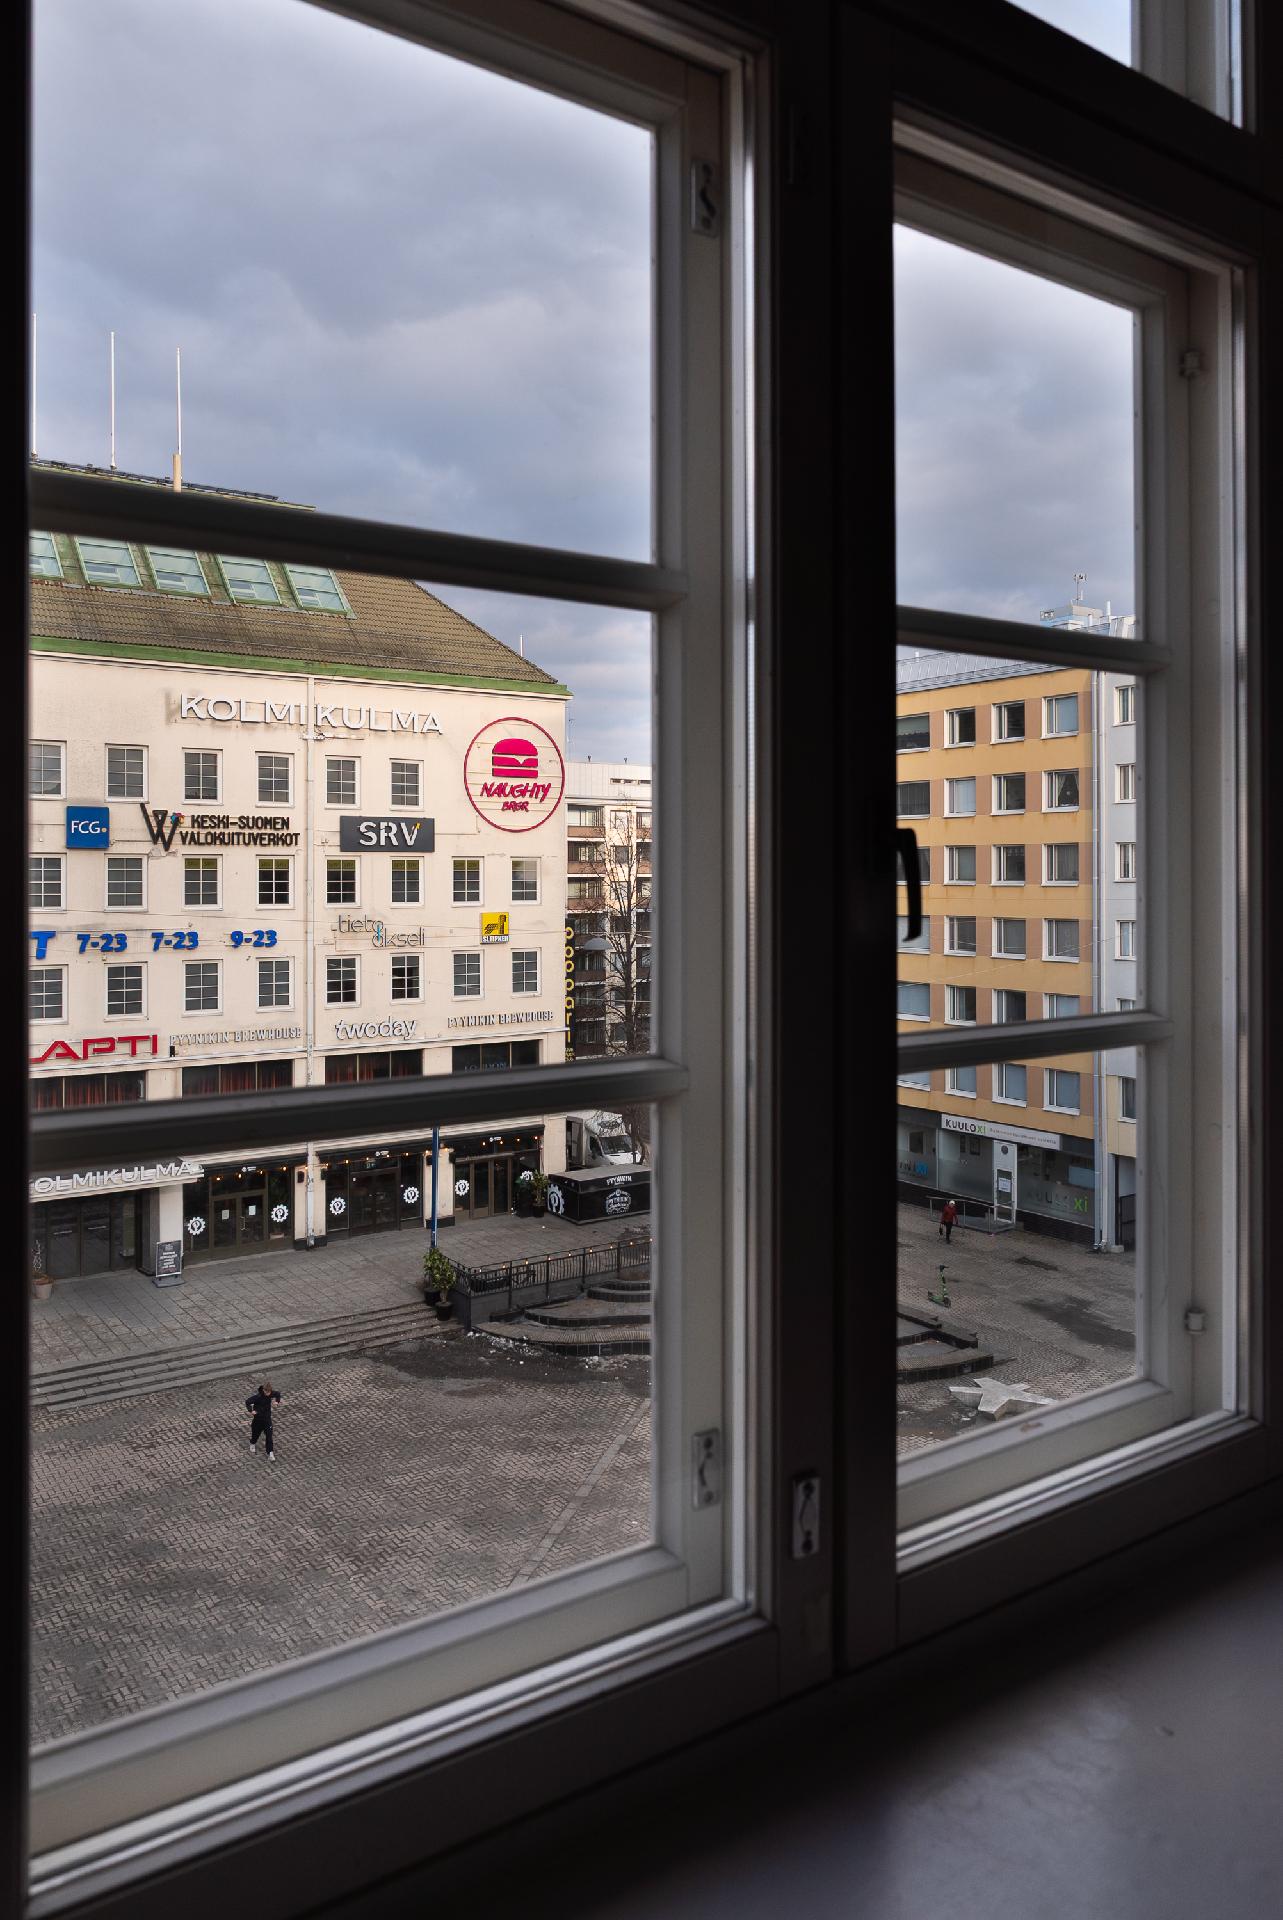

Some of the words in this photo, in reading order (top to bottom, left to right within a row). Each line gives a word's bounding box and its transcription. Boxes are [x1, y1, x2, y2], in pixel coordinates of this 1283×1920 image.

[480, 782, 552, 802] NAUGHTY
[191, 815, 290, 830] KESKI-SUOMEN
[180, 831, 301, 847] VALOKUITUVERKOT
[359, 821, 421, 847] SRV
[77, 933, 128, 954] 7-23
[151, 931, 199, 951] 7-23
[230, 929, 278, 948] 9-23
[170, 1032, 229, 1046] PYYNIKIN
[234, 1027, 302, 1042] BREWHOUSE
[334, 1016, 417, 1041] twoday
[31, 1161, 193, 1194] OLMIKULMA
